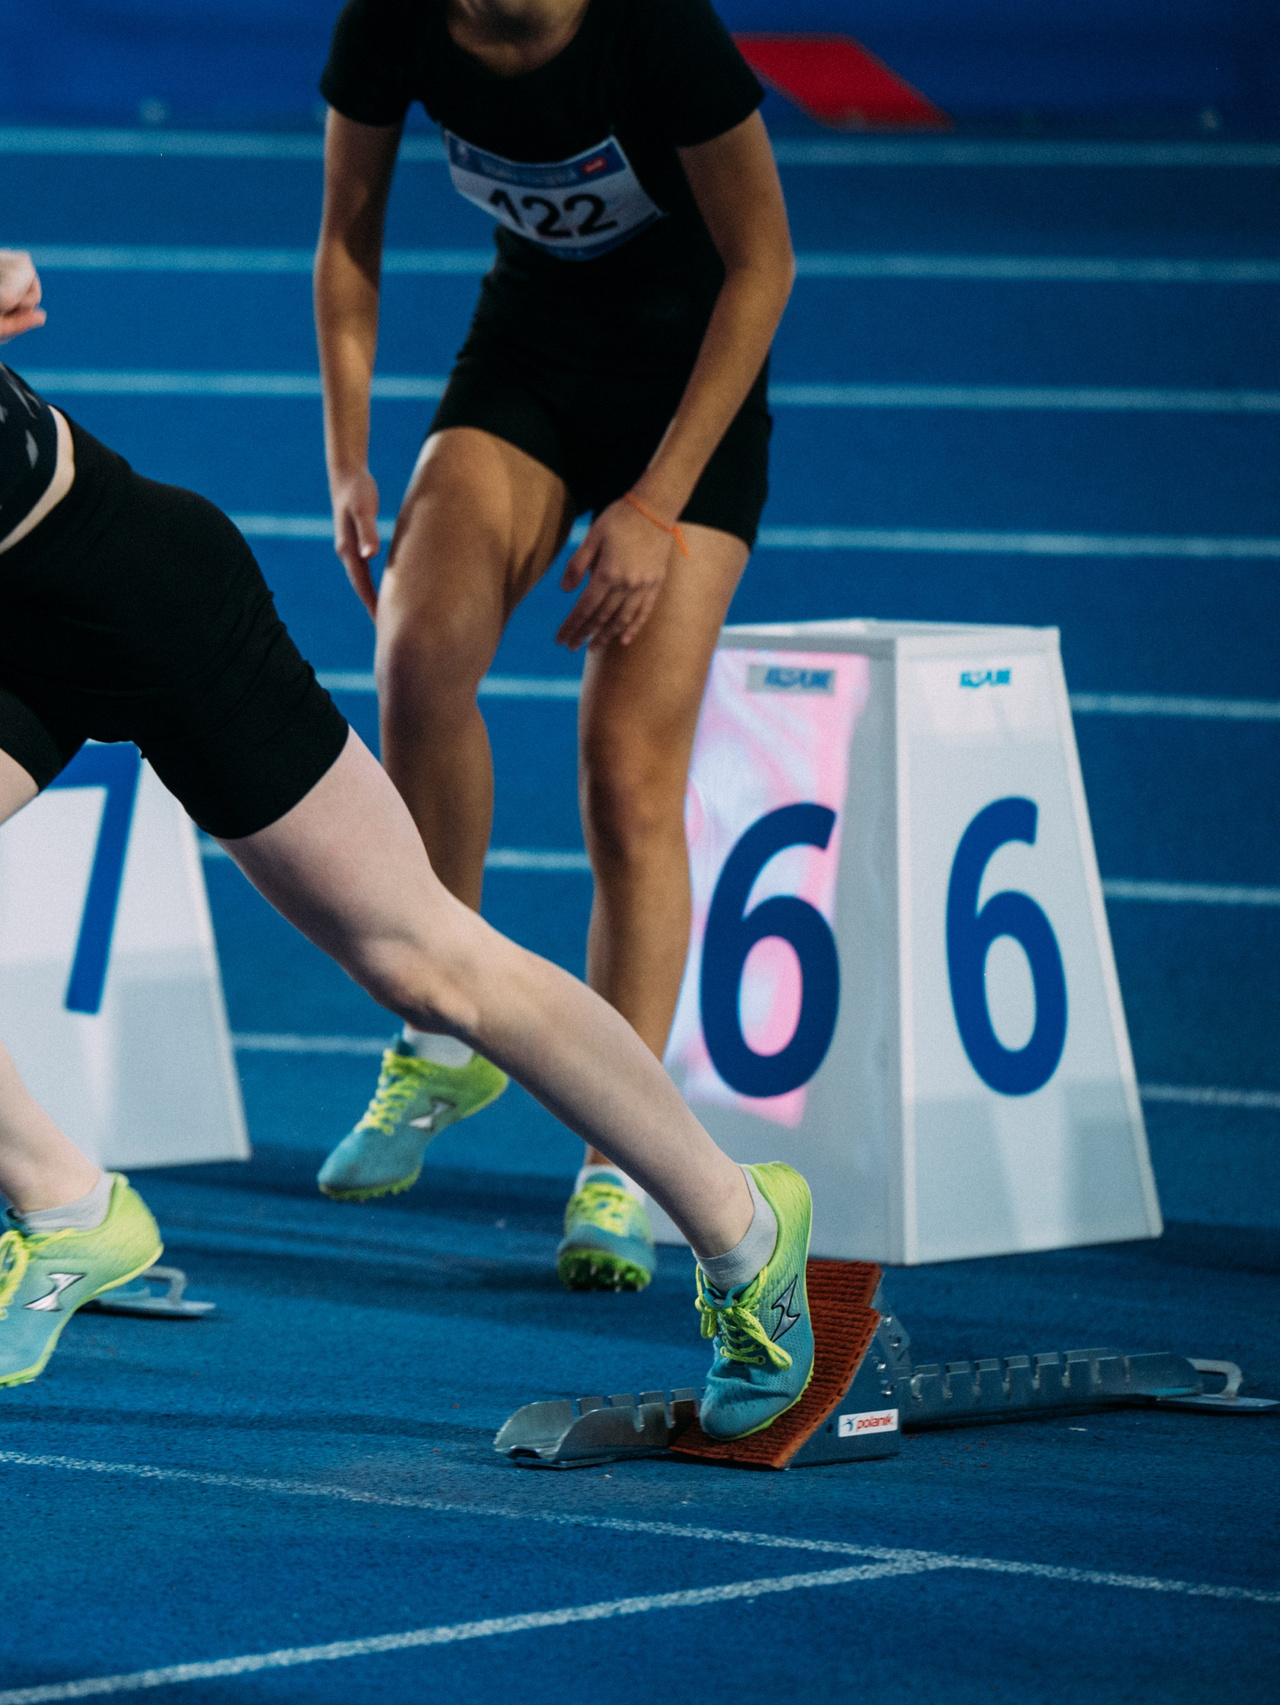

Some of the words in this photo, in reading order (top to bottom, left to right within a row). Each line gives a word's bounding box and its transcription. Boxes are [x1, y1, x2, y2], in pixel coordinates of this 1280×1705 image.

[488, 188, 618, 238] 122
[42, 741, 142, 1015] 7
[699, 801, 841, 1099] 6
[945, 795, 1069, 1098] 6
[856, 1413, 894, 1431] polanik
